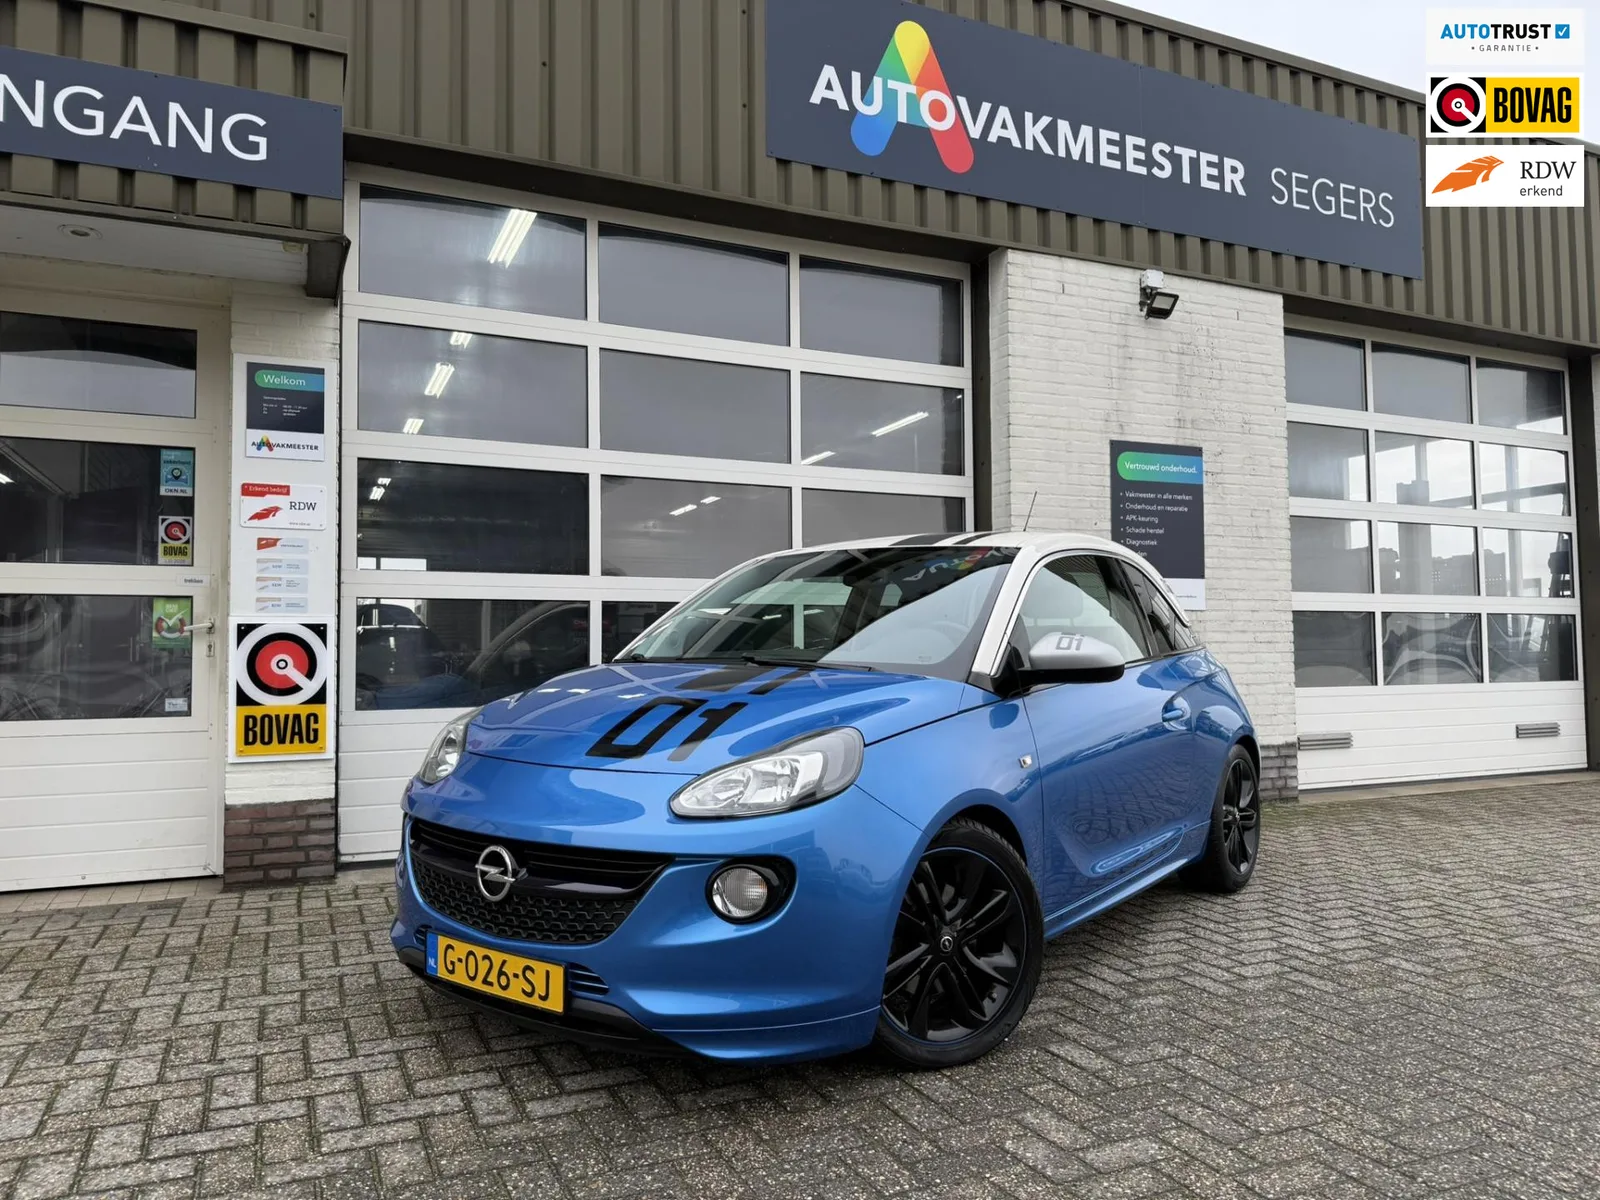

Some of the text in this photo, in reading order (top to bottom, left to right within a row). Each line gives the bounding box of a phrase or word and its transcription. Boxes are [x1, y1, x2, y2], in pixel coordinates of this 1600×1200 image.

[809, 64, 1395, 228] AUTOVAKMEESTER SEGERS
[263, 374, 306, 387] Welkom
[251, 440, 319, 451] AUTOVAKMEESTER
[1124, 461, 1198, 474] Vertrouwd onderhoud.
[1125, 491, 1156, 499] Vakmeester
[289, 501, 317, 511] RDW
[1125, 502, 1157, 511] Onderhoud
[1125, 514, 1159, 524] APK-keuring
[1126, 526, 1146, 534] Schade
[1126, 538, 1158, 547] Diagnostiek
[163, 545, 188, 556] BOVAG
[1055, 635, 1084, 651] 01
[243, 712, 319, 746] BOVAG
[585, 695, 748, 761] 01
[428, 956, 437, 969] NL
[443, 944, 550, 1002] G-026-SJ
